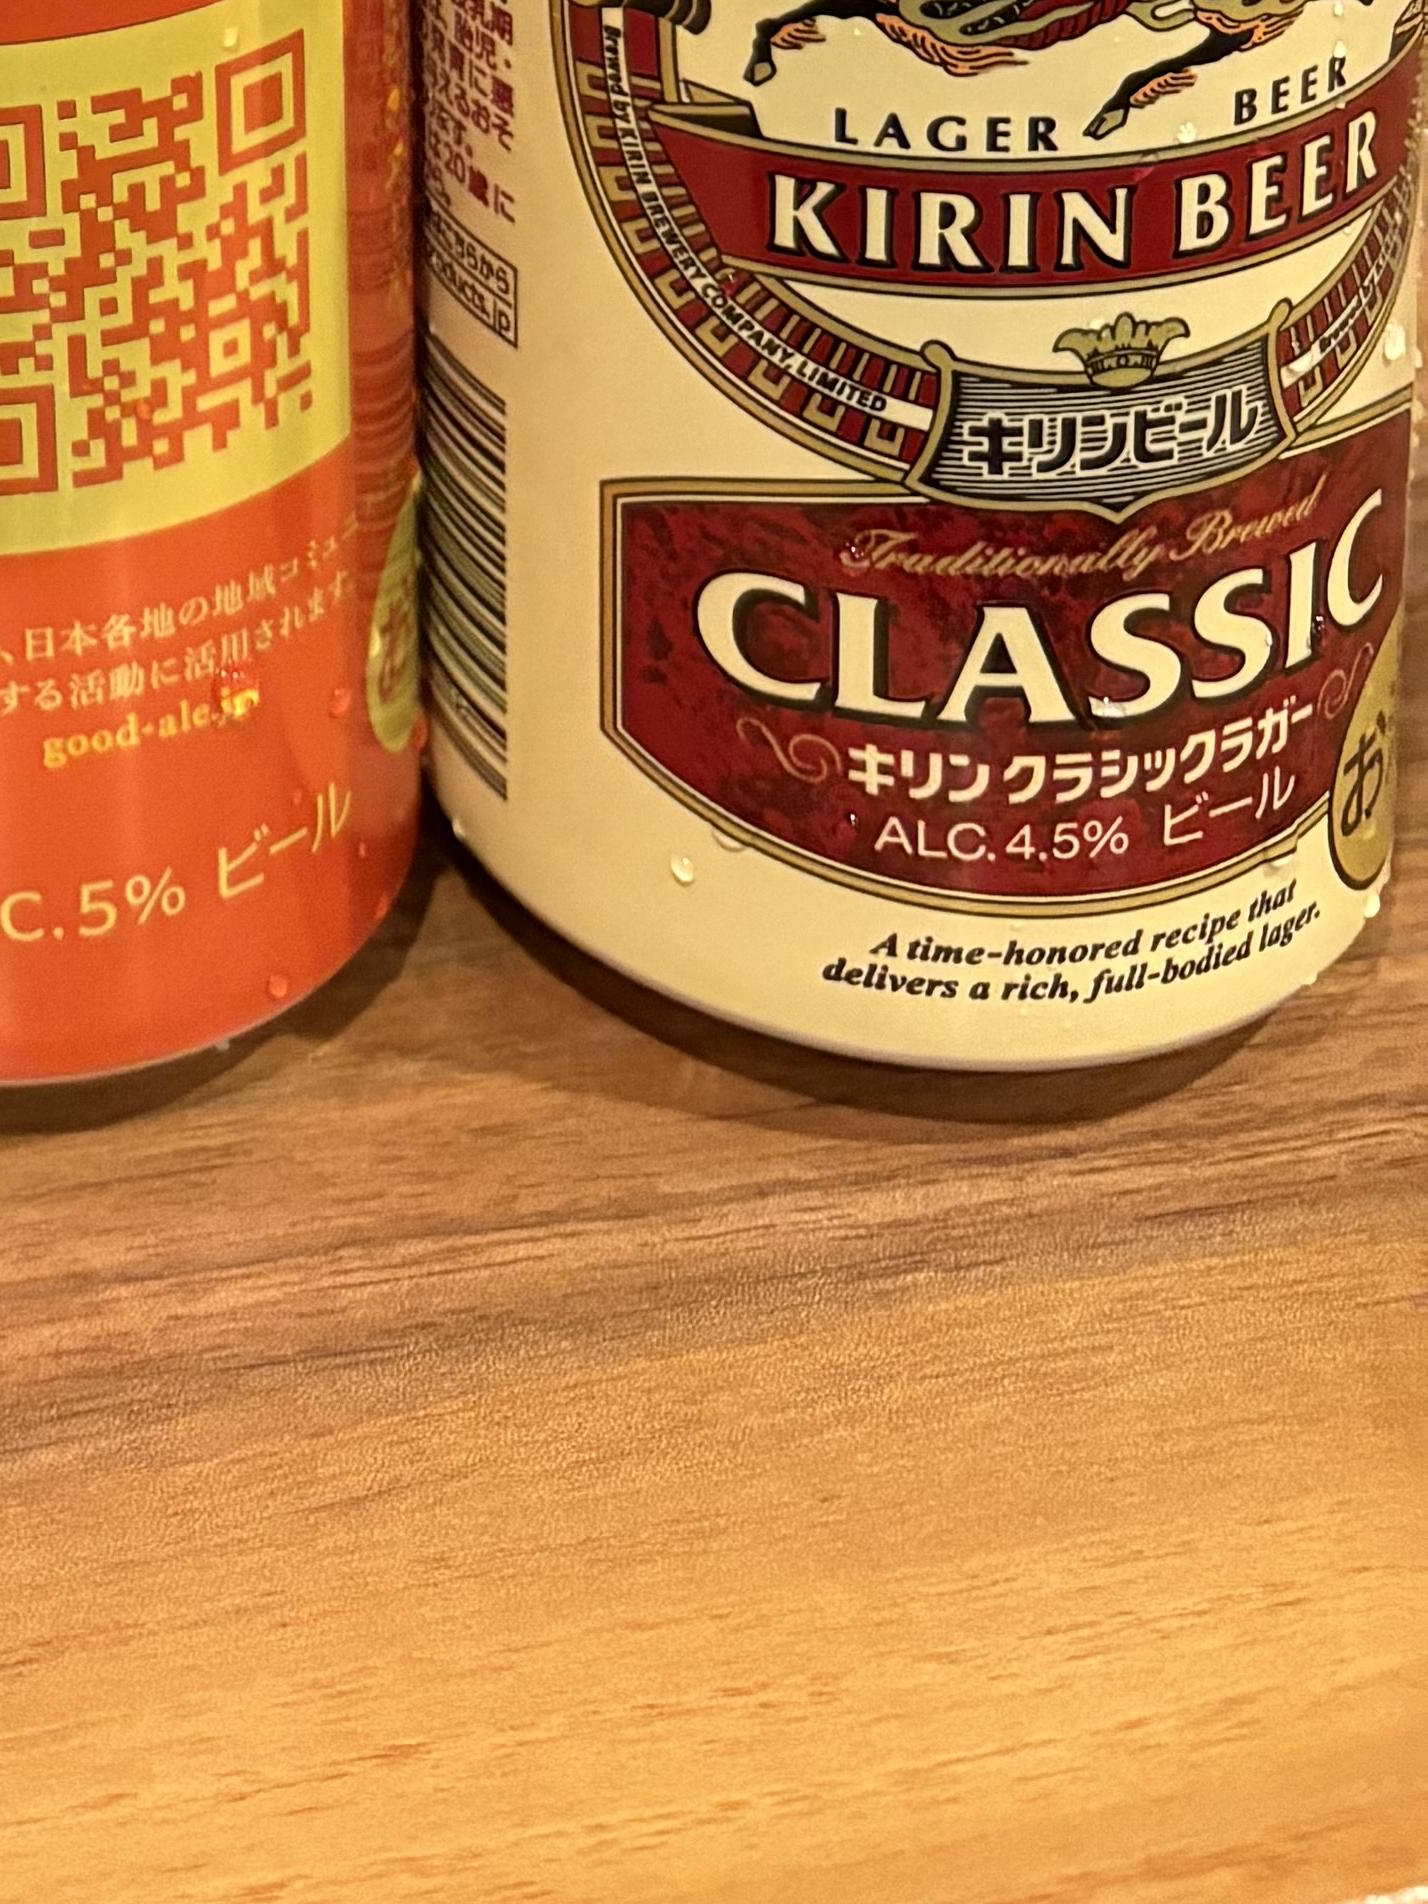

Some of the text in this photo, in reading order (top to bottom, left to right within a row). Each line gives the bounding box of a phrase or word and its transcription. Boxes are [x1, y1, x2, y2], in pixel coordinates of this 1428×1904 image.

[833, 55, 1349, 155] LAGER BEER
[766, 114, 1384, 276] KIRIN BEER
[618, 126, 653, 186] KIRIN
[641, 187, 707, 286] BREWERY
[795, 359, 888, 414] LIMITED
[964, 392, 1262, 480] キリンビール
[1168, 473, 1326, 566] Brewed
[690, 485, 1384, 728] CLASSIC
[216, 780, 352, 901] ビール
[1162, 771, 1296, 849] ビール
[821, 898, 1325, 1006] delivers a rich, full-bodied lager.
[868, 875, 1301, 969] A time-honored recipe that
